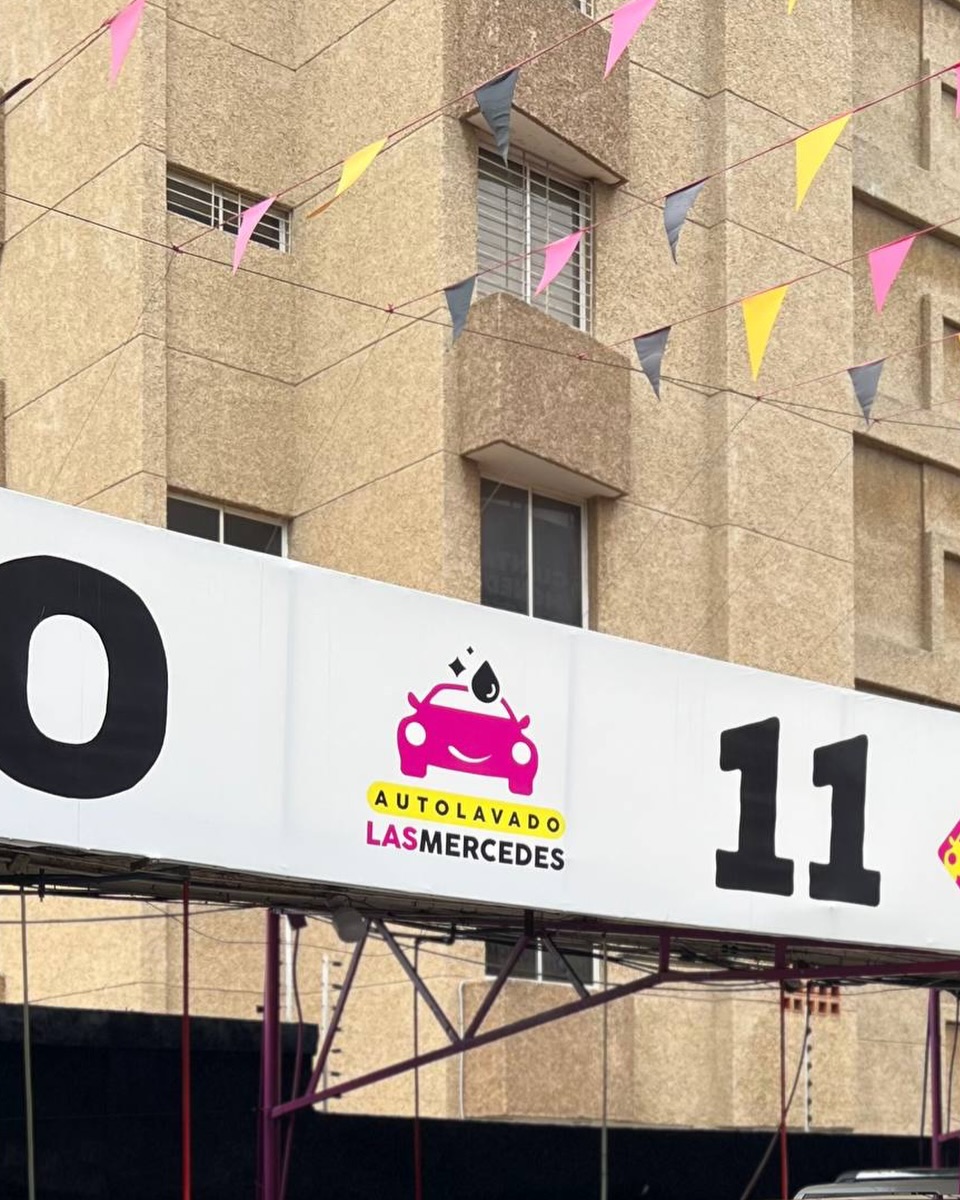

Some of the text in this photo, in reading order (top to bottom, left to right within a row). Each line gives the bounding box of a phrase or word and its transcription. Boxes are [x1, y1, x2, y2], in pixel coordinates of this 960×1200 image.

[374, 790, 561, 833] AUTOLAVADO
[715, 716, 881, 907] 11
[366, 821, 566, 871] LASMERCEDES
